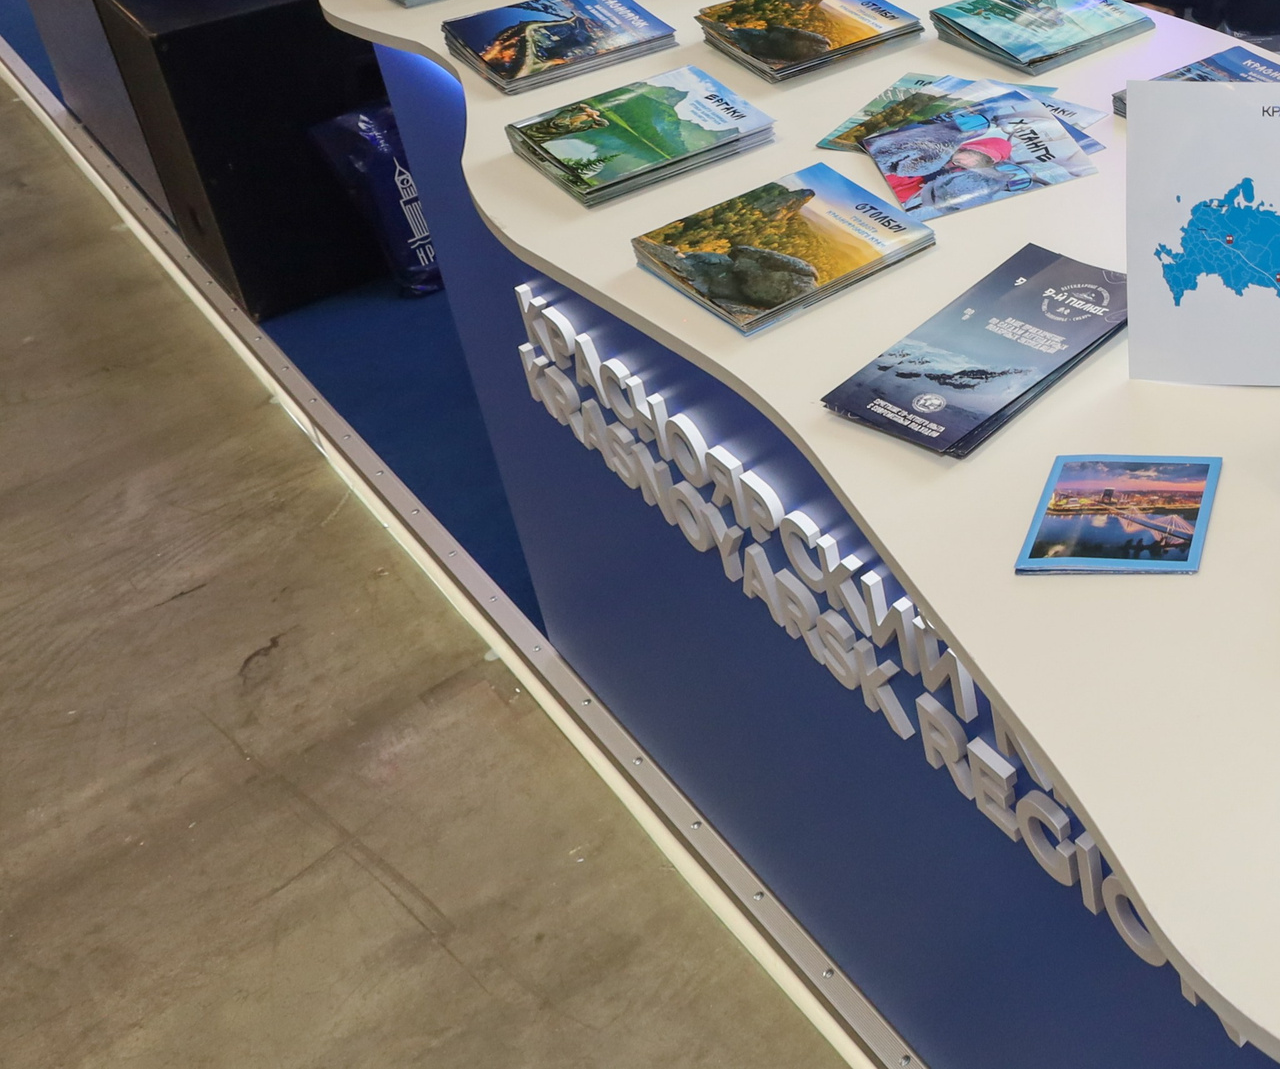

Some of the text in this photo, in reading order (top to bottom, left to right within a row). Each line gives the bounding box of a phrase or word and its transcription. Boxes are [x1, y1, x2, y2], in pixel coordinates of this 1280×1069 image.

[704, 93, 747, 121] ЕРГАКИ
[855, 203, 907, 233] СТОЛБЫ
[1064, 295, 1110, 316] ПОЛЮС
[514, 284, 978, 723] КРАСНОЯРСКИЙ
[518, 342, 915, 740] KRASNOYARSK
[915, 692, 1247, 1047] REGIO
